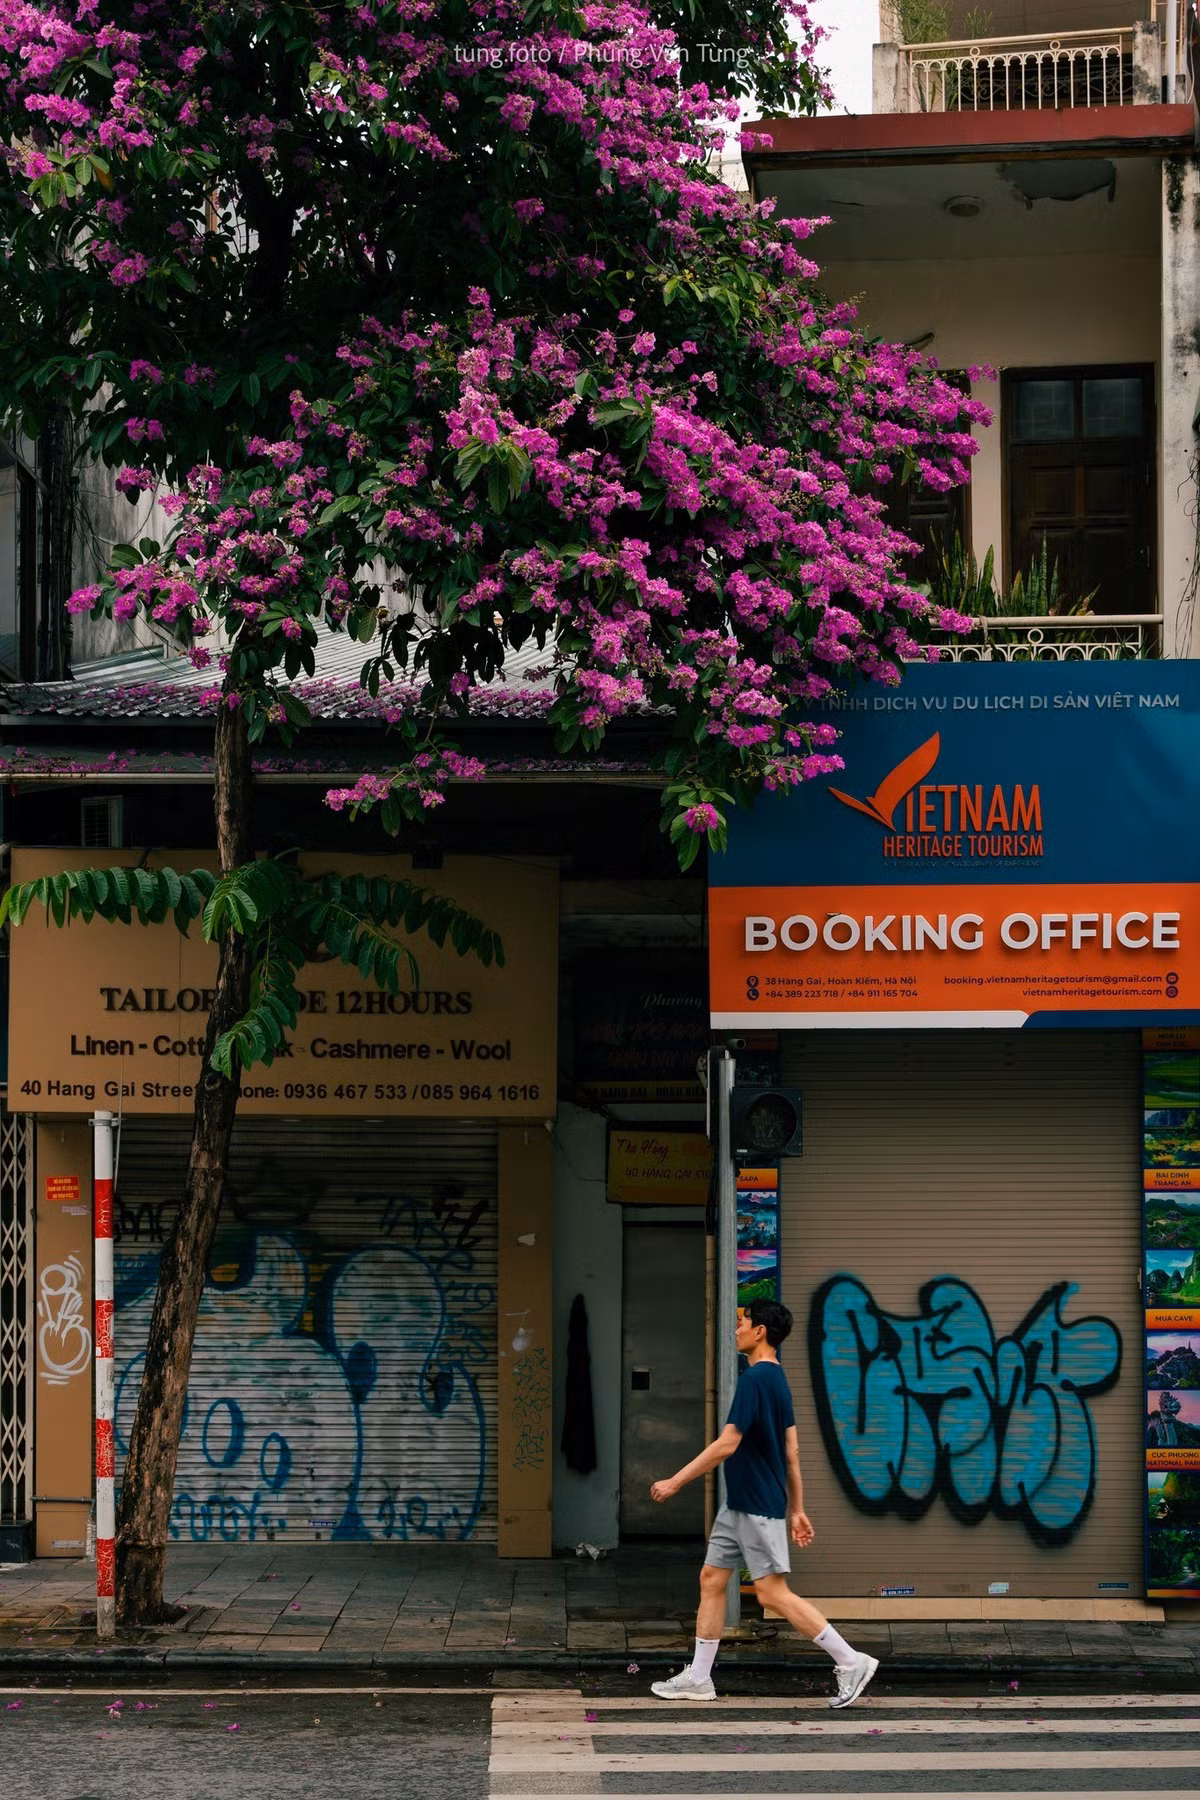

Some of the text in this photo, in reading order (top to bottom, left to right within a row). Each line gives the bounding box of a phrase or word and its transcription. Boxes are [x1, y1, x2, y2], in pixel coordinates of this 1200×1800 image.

[874, 697, 917, 713] DỊCH
[922, 696, 947, 713] VỤ
[953, 696, 979, 710] DU
[984, 696, 1024, 712] LỊCH
[1029, 696, 1048, 709] DI
[1053, 692, 1090, 709] SẢN
[1094, 691, 1133, 711] VIỆT
[1139, 694, 1180, 708] NAM
[883, 834, 1044, 858] HERITAGE TOURISM
[744, 911, 1180, 952] BOOKING OFFICE
[765, 977, 777, 985] 38
[778, 976, 804, 988] Hàng
[806, 976, 826, 986] Gai,
[828, 976, 853, 985] Hoàn
[885, 976, 898, 985] Hà
[900, 976, 917, 986] Nội
[944, 974, 1162, 985] booking.vietnamheritagetourism@gmail.com
[337, 991, 473, 1015] 12HOURS
[765, 989, 783, 998] +84
[785, 989, 802, 998] 389
[804, 989, 821, 998] 223
[823, 988, 839, 998] 718
[847, 988, 865, 998] +84
[868, 988, 880, 997] 911
[883, 988, 898, 997] 165
[900, 988, 918, 997] 704
[1022, 987, 1162, 998] vietnamheritagetourism.com
[71, 1034, 134, 1056] Linen
[153, 1034, 205, 1056] Cott
[310, 1038, 431, 1060] Cashmere
[450, 1039, 512, 1060] Wool
[20, 1081, 42, 1095] 40
[47, 1081, 95, 1099] Hang
[104, 1081, 135, 1097] Gai
[142, 1082, 197, 1097] Stree
[284, 1084, 327, 1099] 0936
[334, 1084, 368, 1099] 467
[374, 1085, 407, 1100] 533
[460, 1085, 493, 1100] 964
[499, 1085, 539, 1100] 1616
